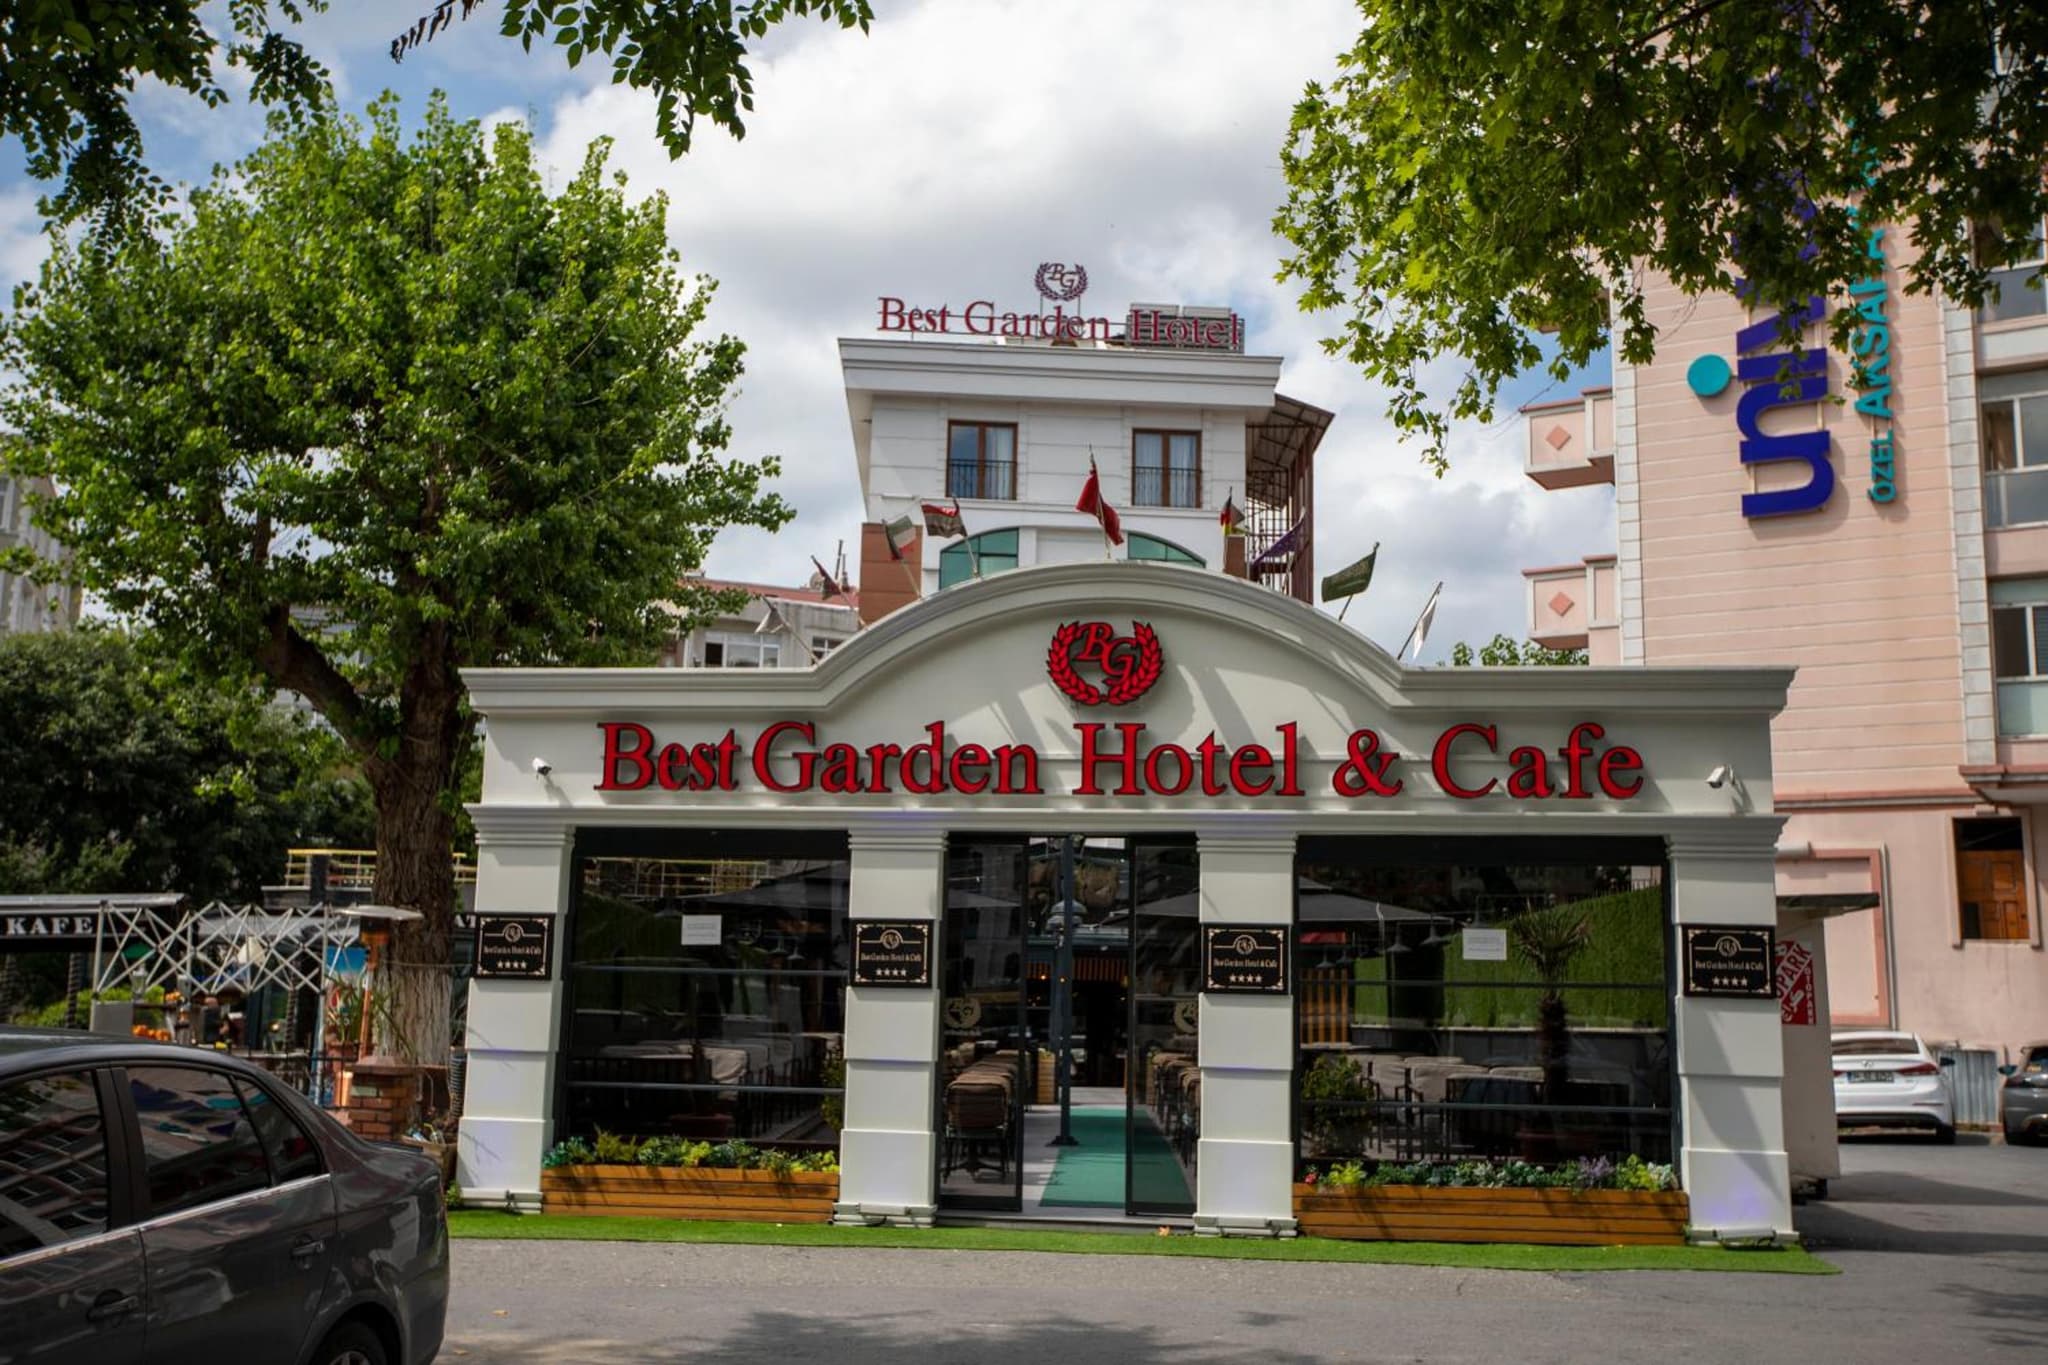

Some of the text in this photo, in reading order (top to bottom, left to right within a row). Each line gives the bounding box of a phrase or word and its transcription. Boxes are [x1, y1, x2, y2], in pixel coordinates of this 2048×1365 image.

[877, 297, 1239, 347] Best Garden Hotel
[1073, 622, 1138, 687] BG
[594, 720, 1645, 800] Best Garden Hotel & Cafe
[6, 916, 94, 935] KAFE
